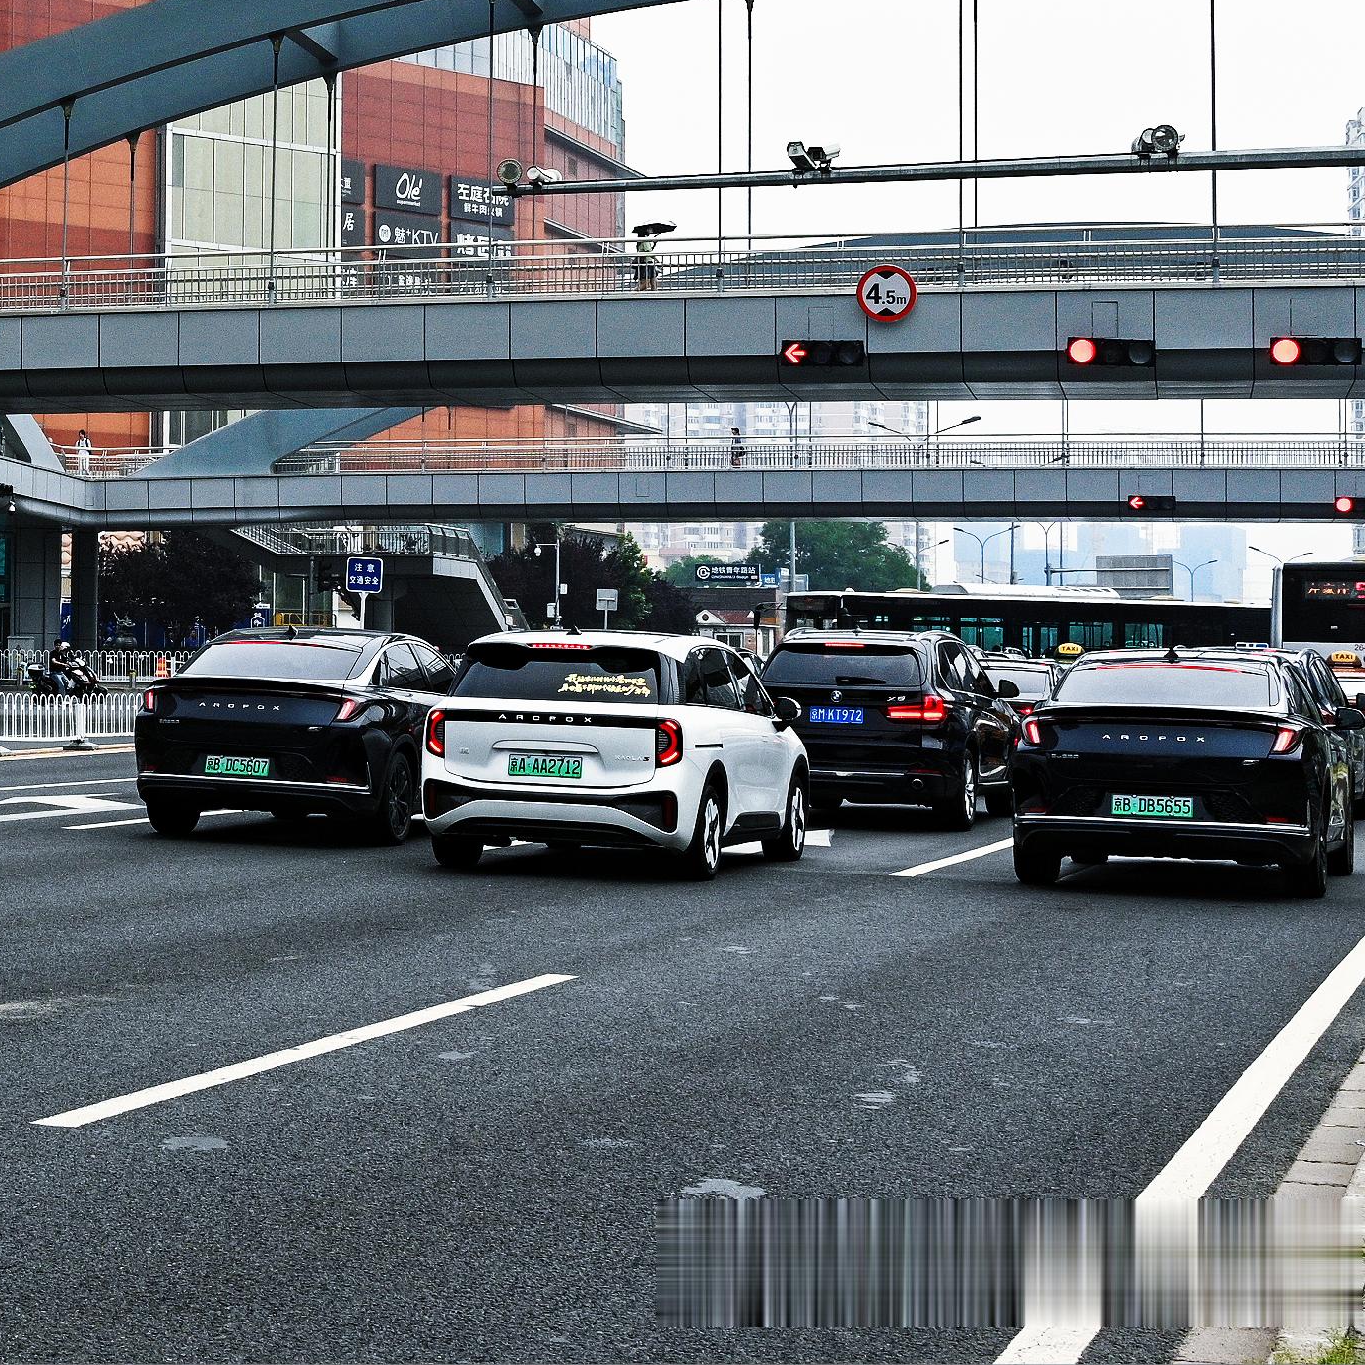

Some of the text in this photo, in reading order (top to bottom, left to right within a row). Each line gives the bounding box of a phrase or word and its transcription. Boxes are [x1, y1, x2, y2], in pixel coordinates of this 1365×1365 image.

[866, 283, 907, 305] 4.5m
[354, 563, 375, 573] 注意
[349, 575, 379, 585] 交通安全
[1334, 653, 1353, 661] TAXI
[498, 713, 592, 723] ARCFOX
